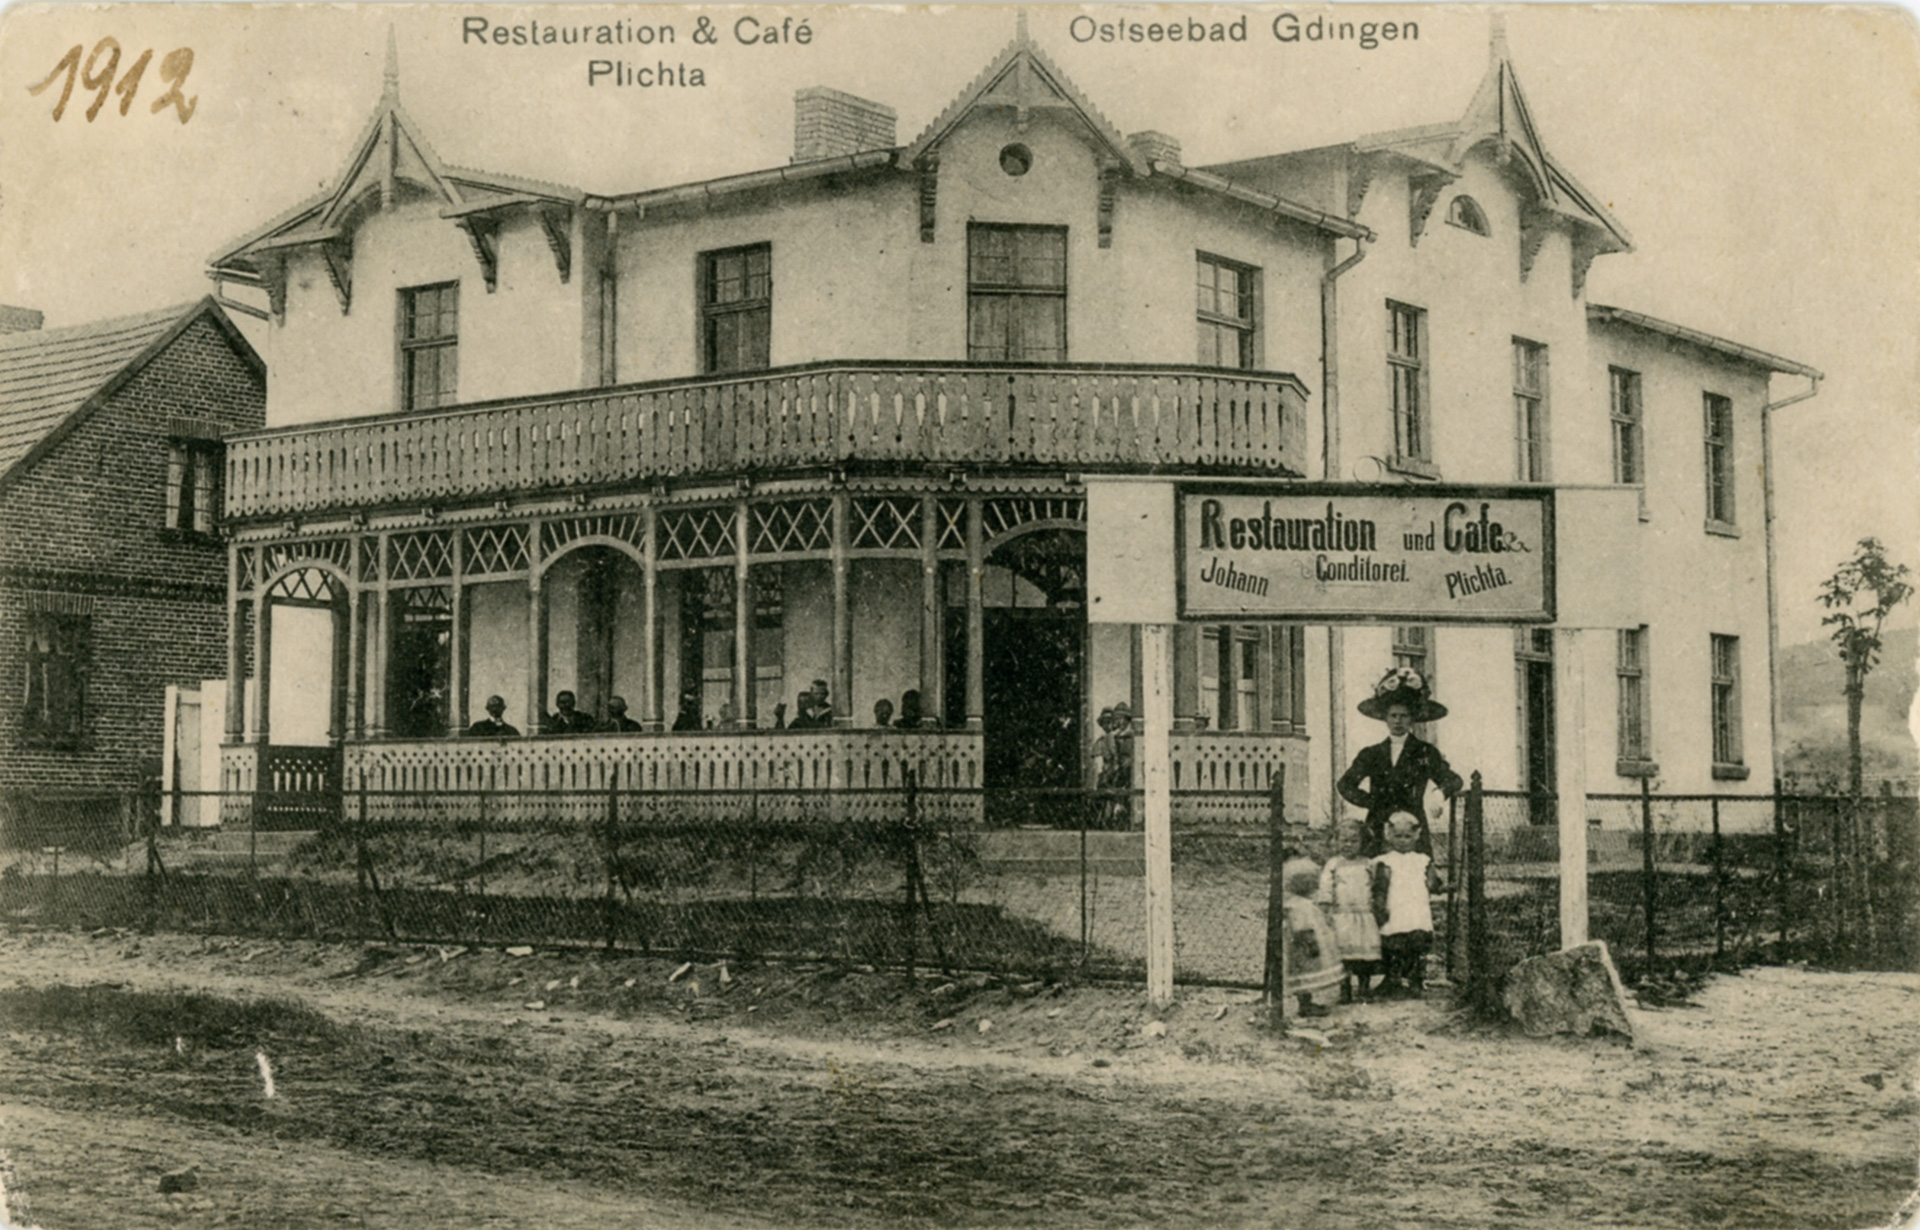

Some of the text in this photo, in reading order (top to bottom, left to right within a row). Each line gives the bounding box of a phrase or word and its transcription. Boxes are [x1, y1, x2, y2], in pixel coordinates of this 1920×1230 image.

[27, 36, 198, 125] 1912
[1200, 498, 1376, 551] Restauration
[1403, 521, 1435, 551] und
[1444, 501, 1503, 553] Cafe
[1201, 554, 1513, 599] Johann Conditorei. Plichta.
